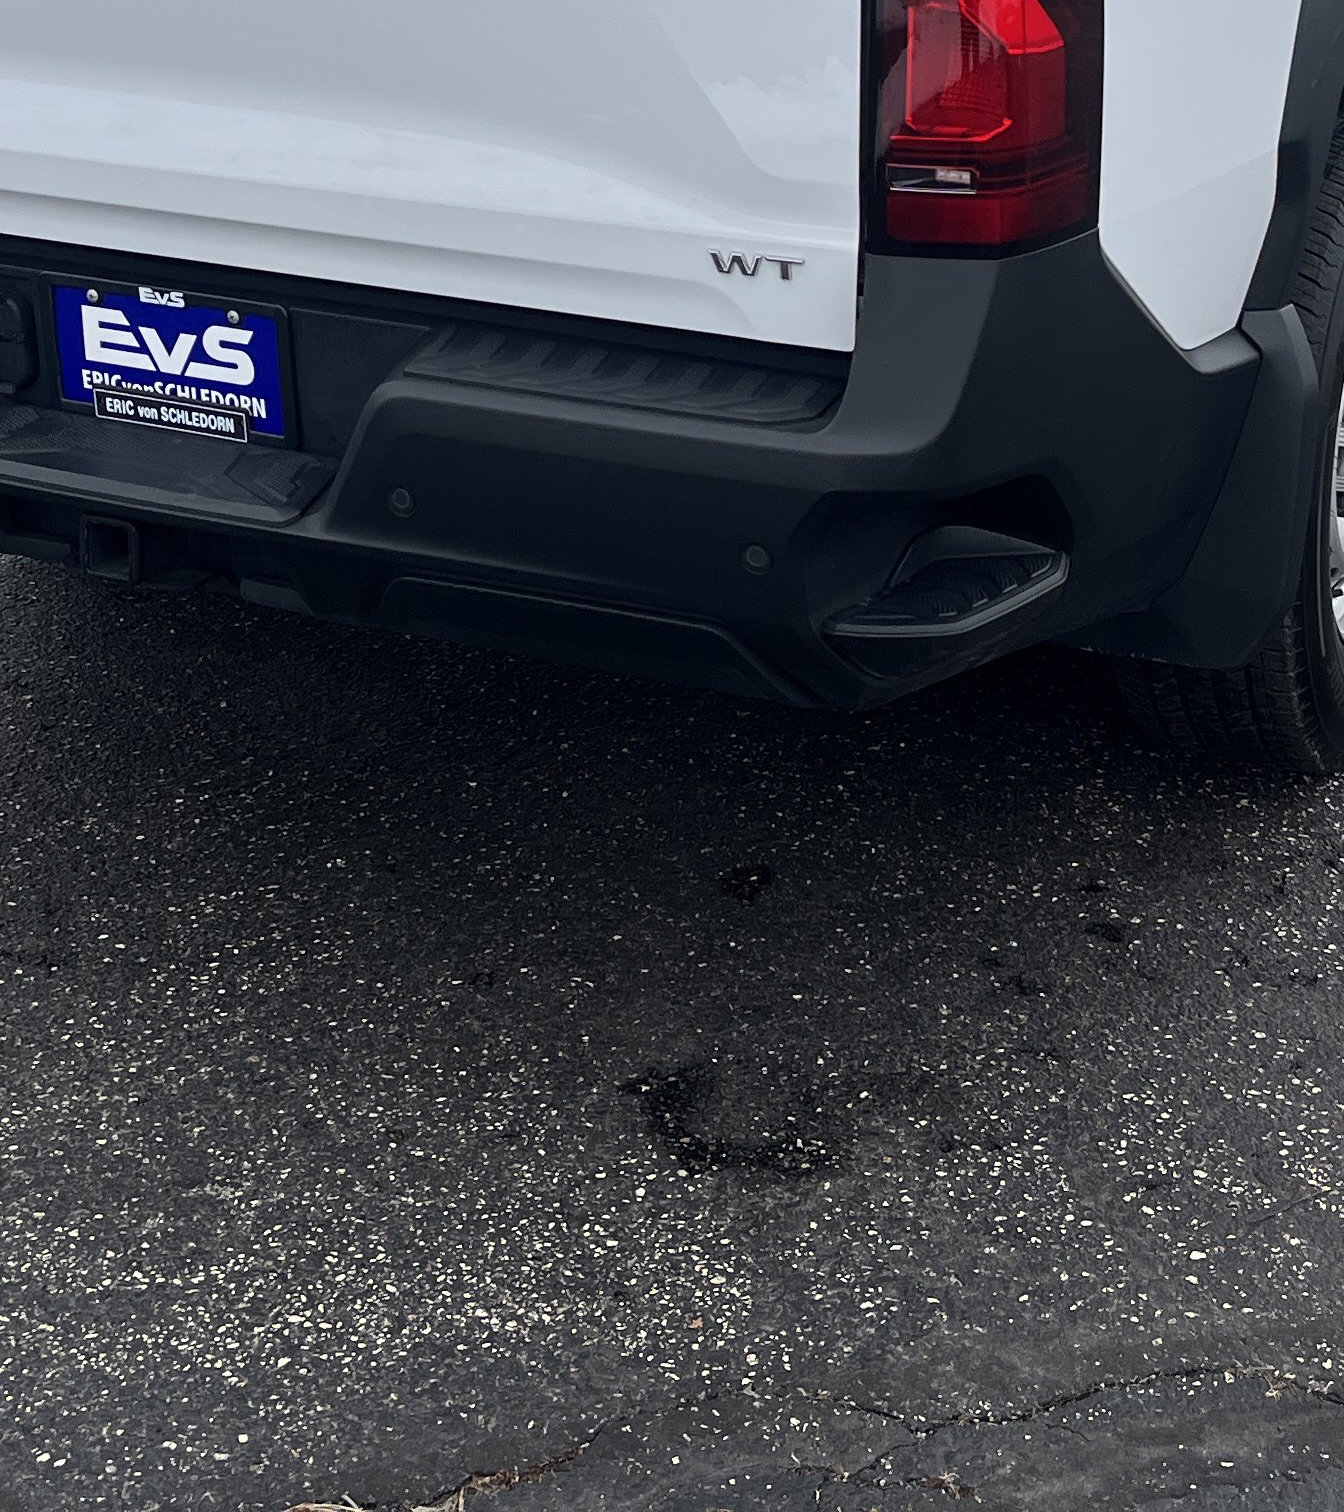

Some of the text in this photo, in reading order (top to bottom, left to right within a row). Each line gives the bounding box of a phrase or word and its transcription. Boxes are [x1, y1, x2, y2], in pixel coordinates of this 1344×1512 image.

[707, 248, 805, 281] WT
[105, 397, 236, 434] ERIC von SCHLEDORN
